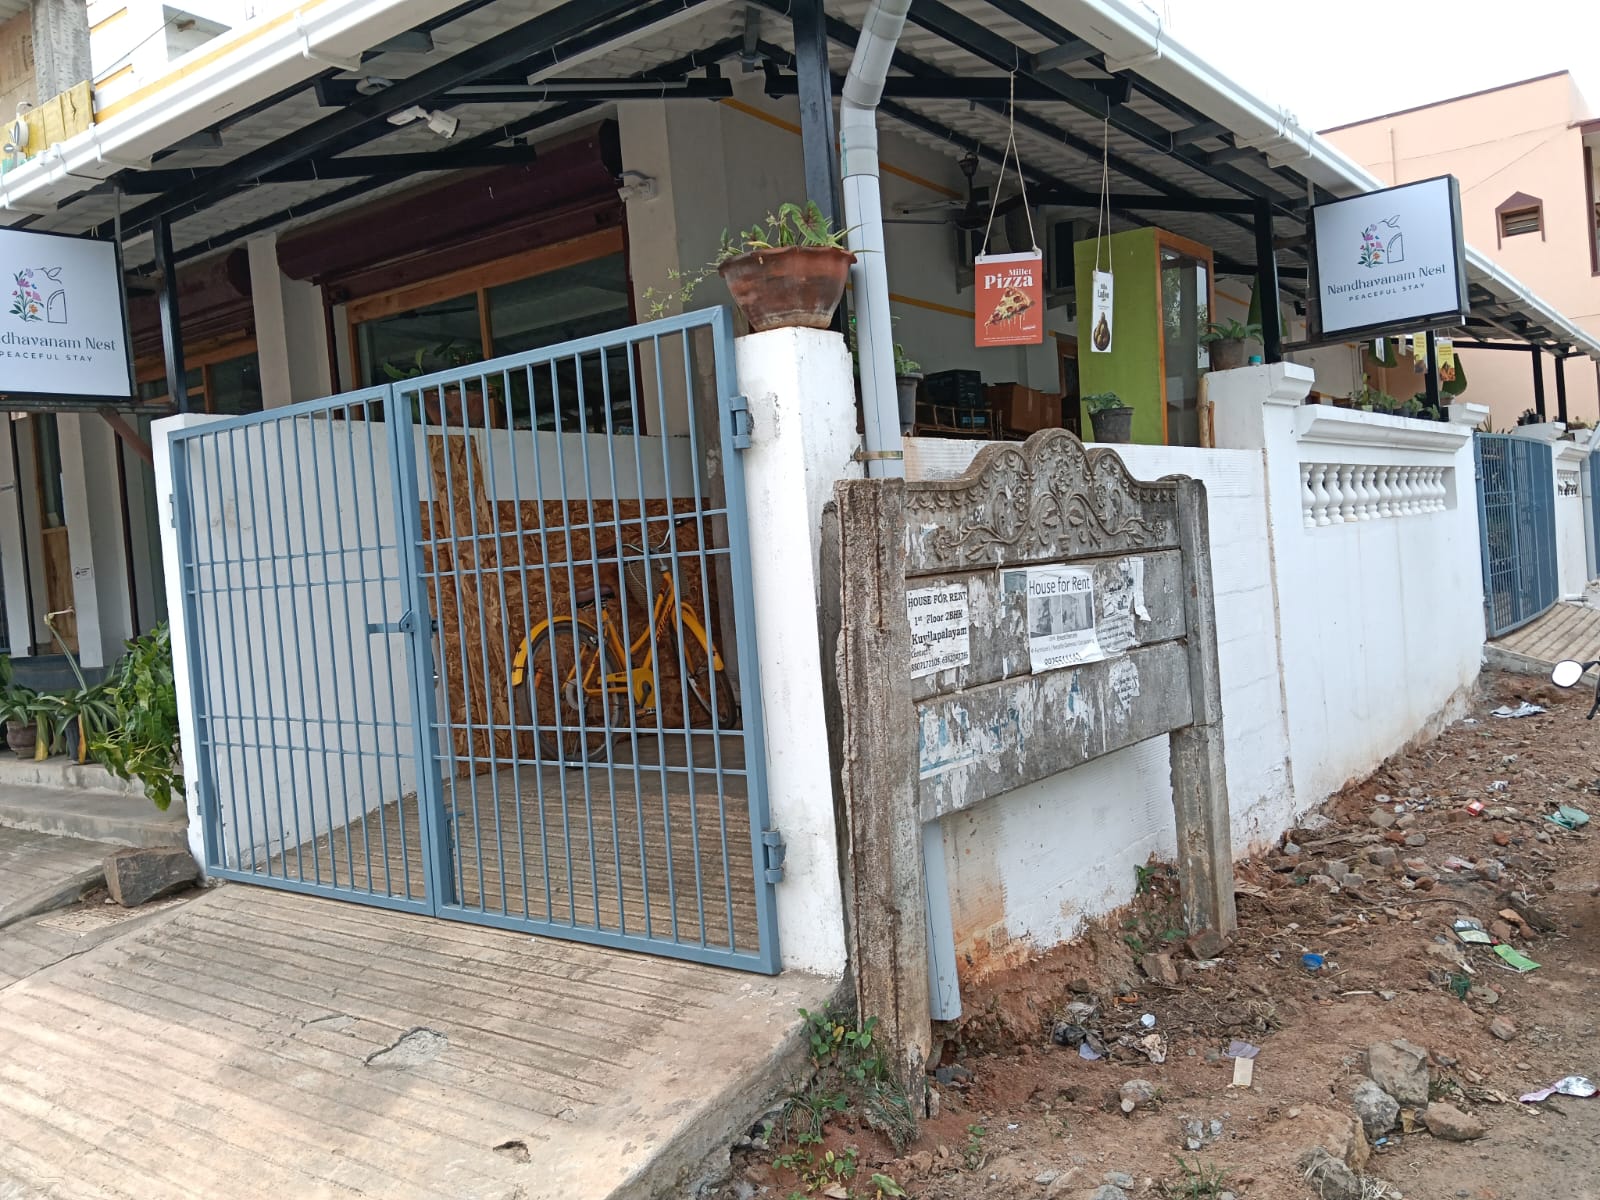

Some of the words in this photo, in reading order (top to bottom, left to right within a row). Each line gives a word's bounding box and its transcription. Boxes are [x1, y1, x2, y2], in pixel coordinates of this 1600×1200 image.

[1008, 268, 1032, 276] Millet
[1327, 271, 1416, 295] Nandhavanam
[1419, 264, 1446, 277] Nest
[984, 273, 1033, 290] Pizza
[1348, 288, 1397, 301] PEACEFUL
[1402, 283, 1425, 292] STAY
[0, 331, 81, 349] dhavanam
[86, 337, 116, 351] Nest
[0, 350, 59, 361] PEACEFUL
[66, 354, 93, 362] STAY
[1029, 580, 1056, 595] House
[1058, 577, 1070, 592] for
[1072, 576, 1090, 591] Rent
[908, 595, 932, 608] HOUSE
[933, 593, 949, 604] FOR
[949, 591, 967, 602] RENT
[926, 613, 943, 624] Floor
[945, 609, 963, 620] 2BHK
